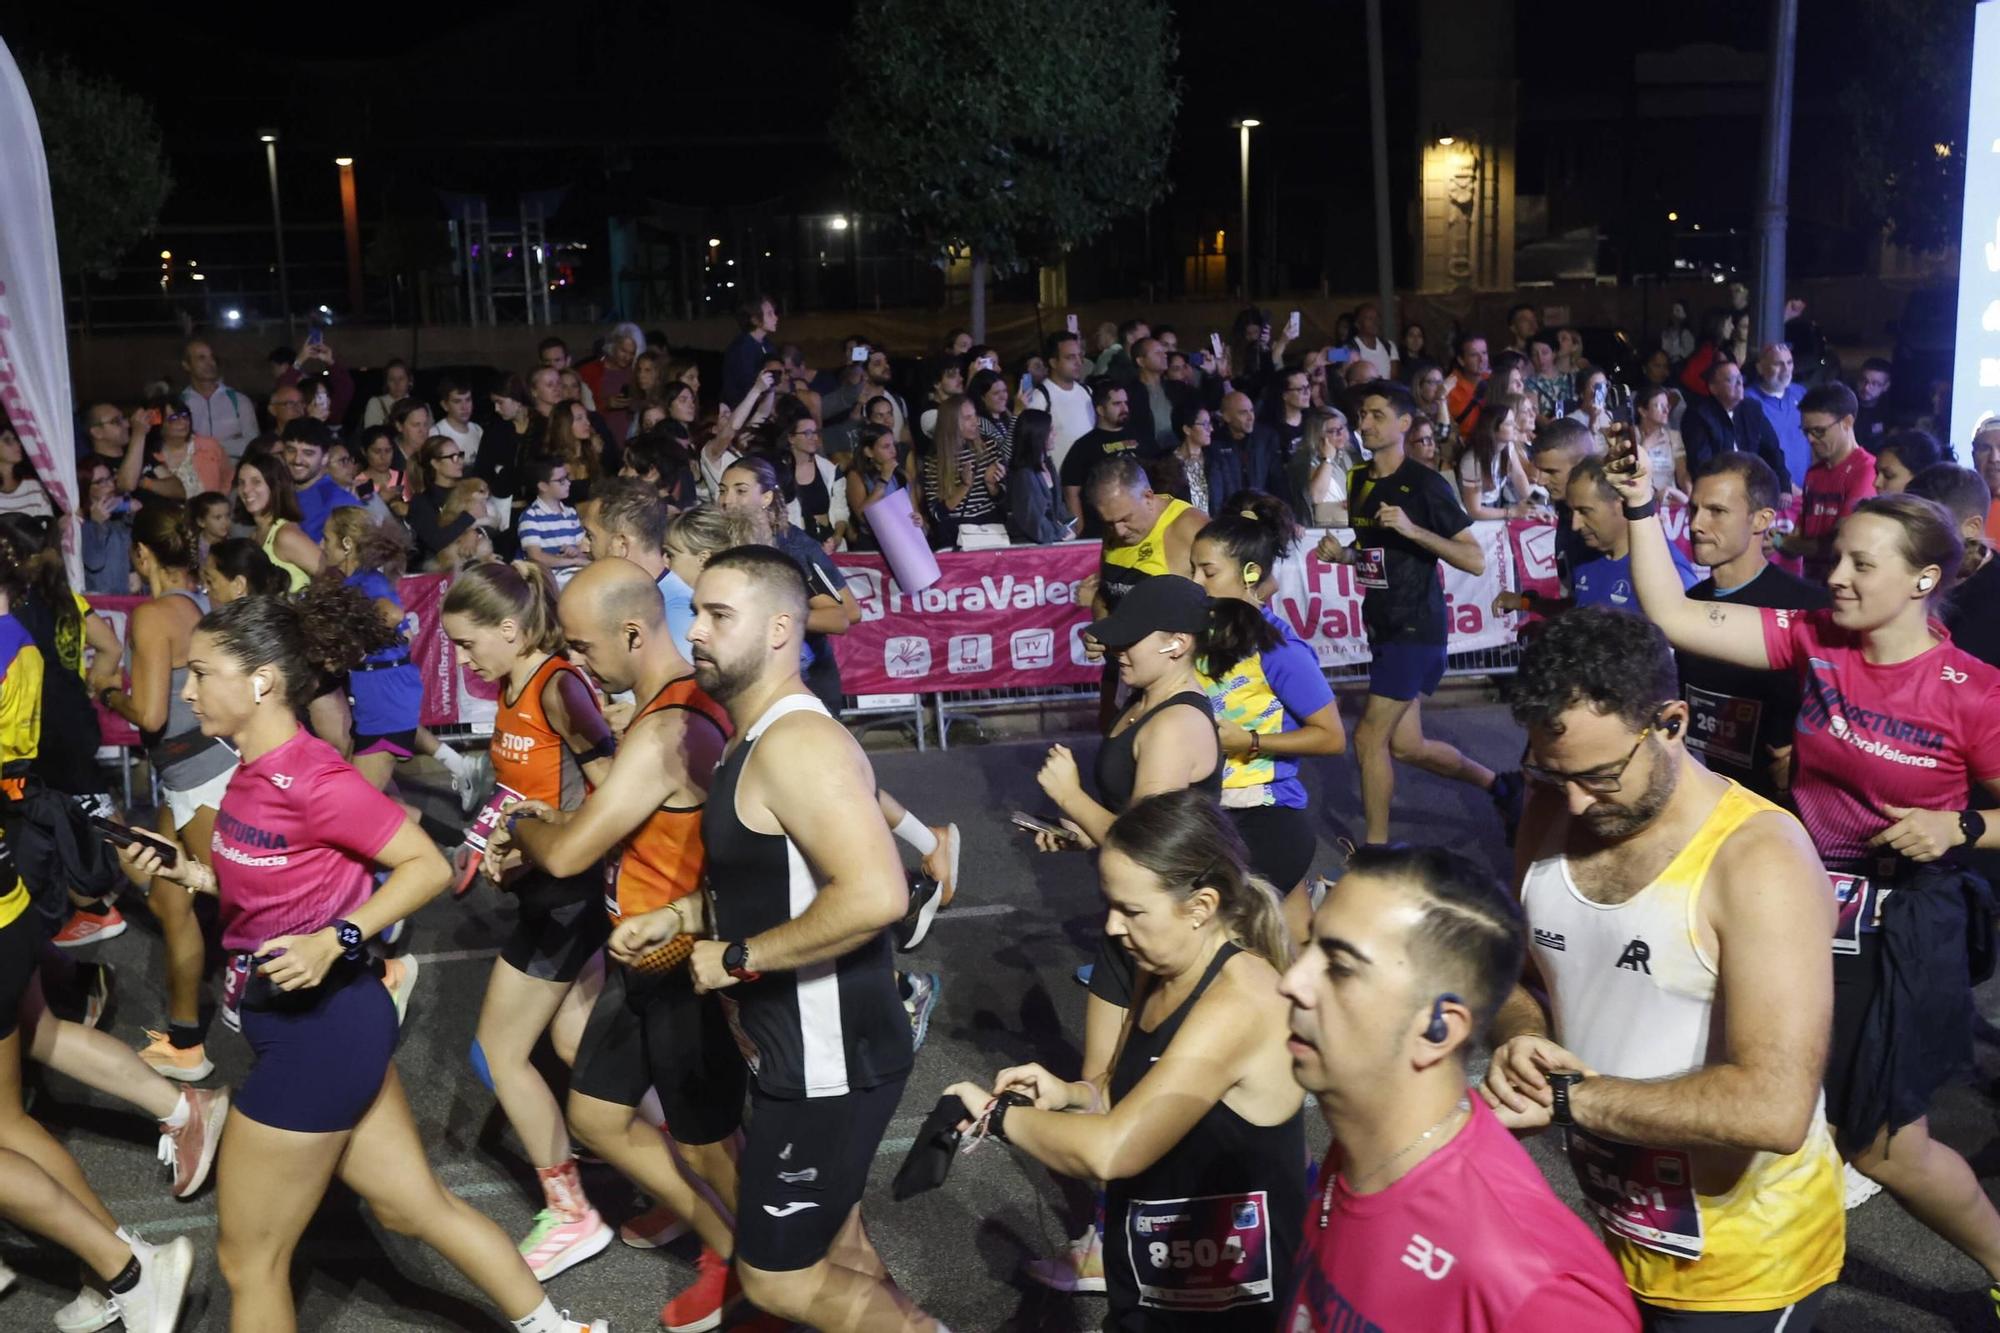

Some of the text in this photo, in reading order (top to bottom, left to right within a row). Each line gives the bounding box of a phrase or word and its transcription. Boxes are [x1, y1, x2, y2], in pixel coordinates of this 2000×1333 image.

[1024, 641, 1041, 651] TV
[502, 733, 535, 751] STOP
[1148, 1235, 1247, 1269] 8504
